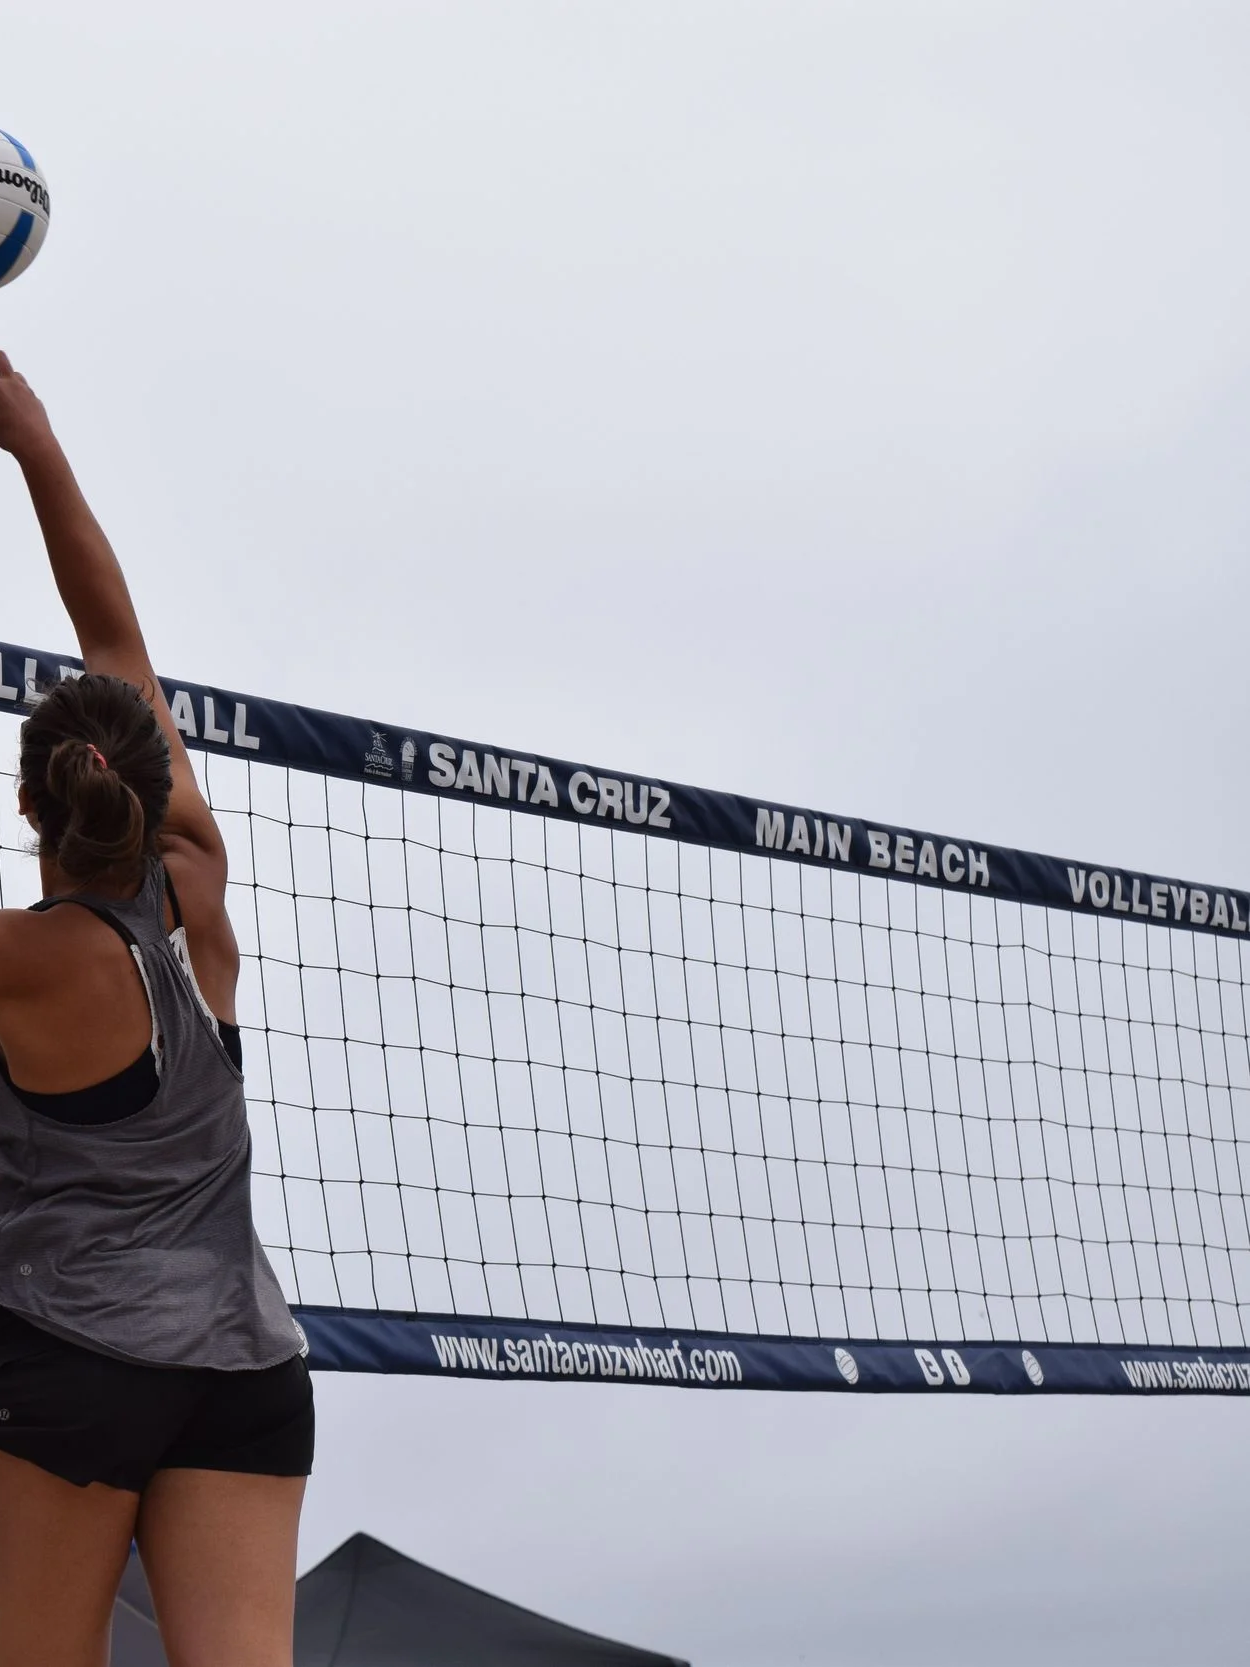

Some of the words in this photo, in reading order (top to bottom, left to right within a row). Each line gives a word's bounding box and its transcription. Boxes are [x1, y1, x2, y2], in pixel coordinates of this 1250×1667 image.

[428, 743, 558, 807] SANTA
[568, 771, 671, 829] CRUZ
[755, 808, 852, 862] MAIN
[868, 830, 990, 887] BEACH
[1067, 867, 1250, 932] VOLLEYBAL
[431, 1333, 743, 1382] www.santacruzwharf.com
